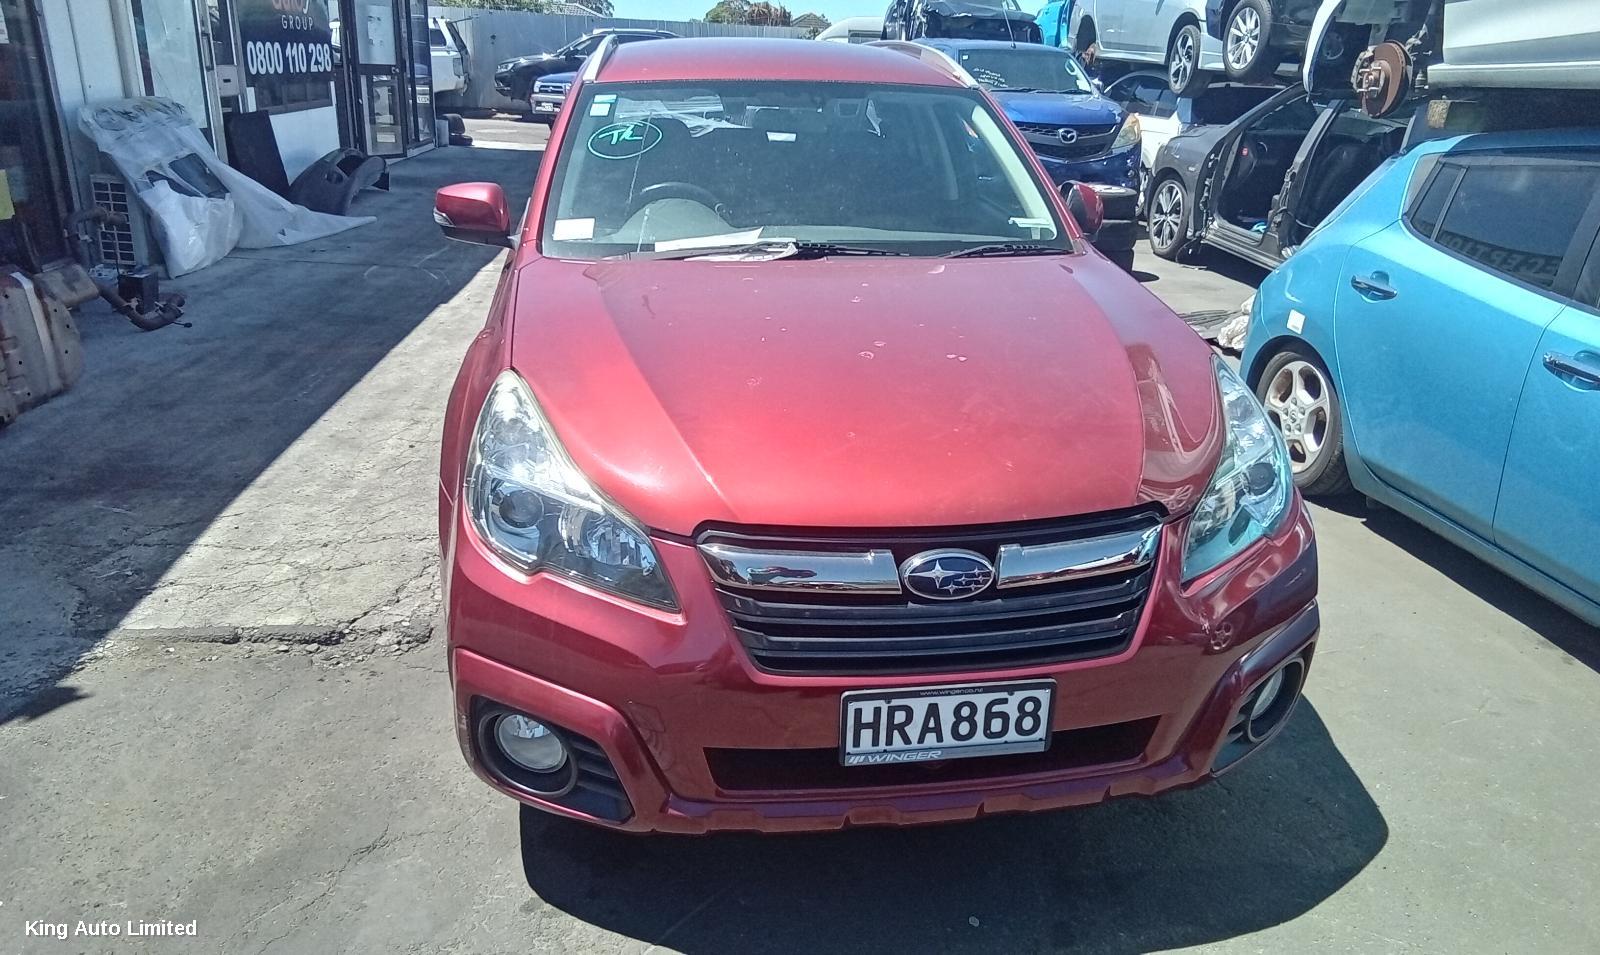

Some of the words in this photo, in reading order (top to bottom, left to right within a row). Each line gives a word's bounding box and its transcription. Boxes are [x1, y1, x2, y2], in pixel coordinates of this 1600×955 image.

[281, 14, 313, 30] GROUP
[246, 41, 284, 75] 0800
[285, 42, 307, 74] 110
[308, 43, 332, 72] 298
[852, 696, 1042, 748] HRA868
[867, 750, 942, 763] WINGER
